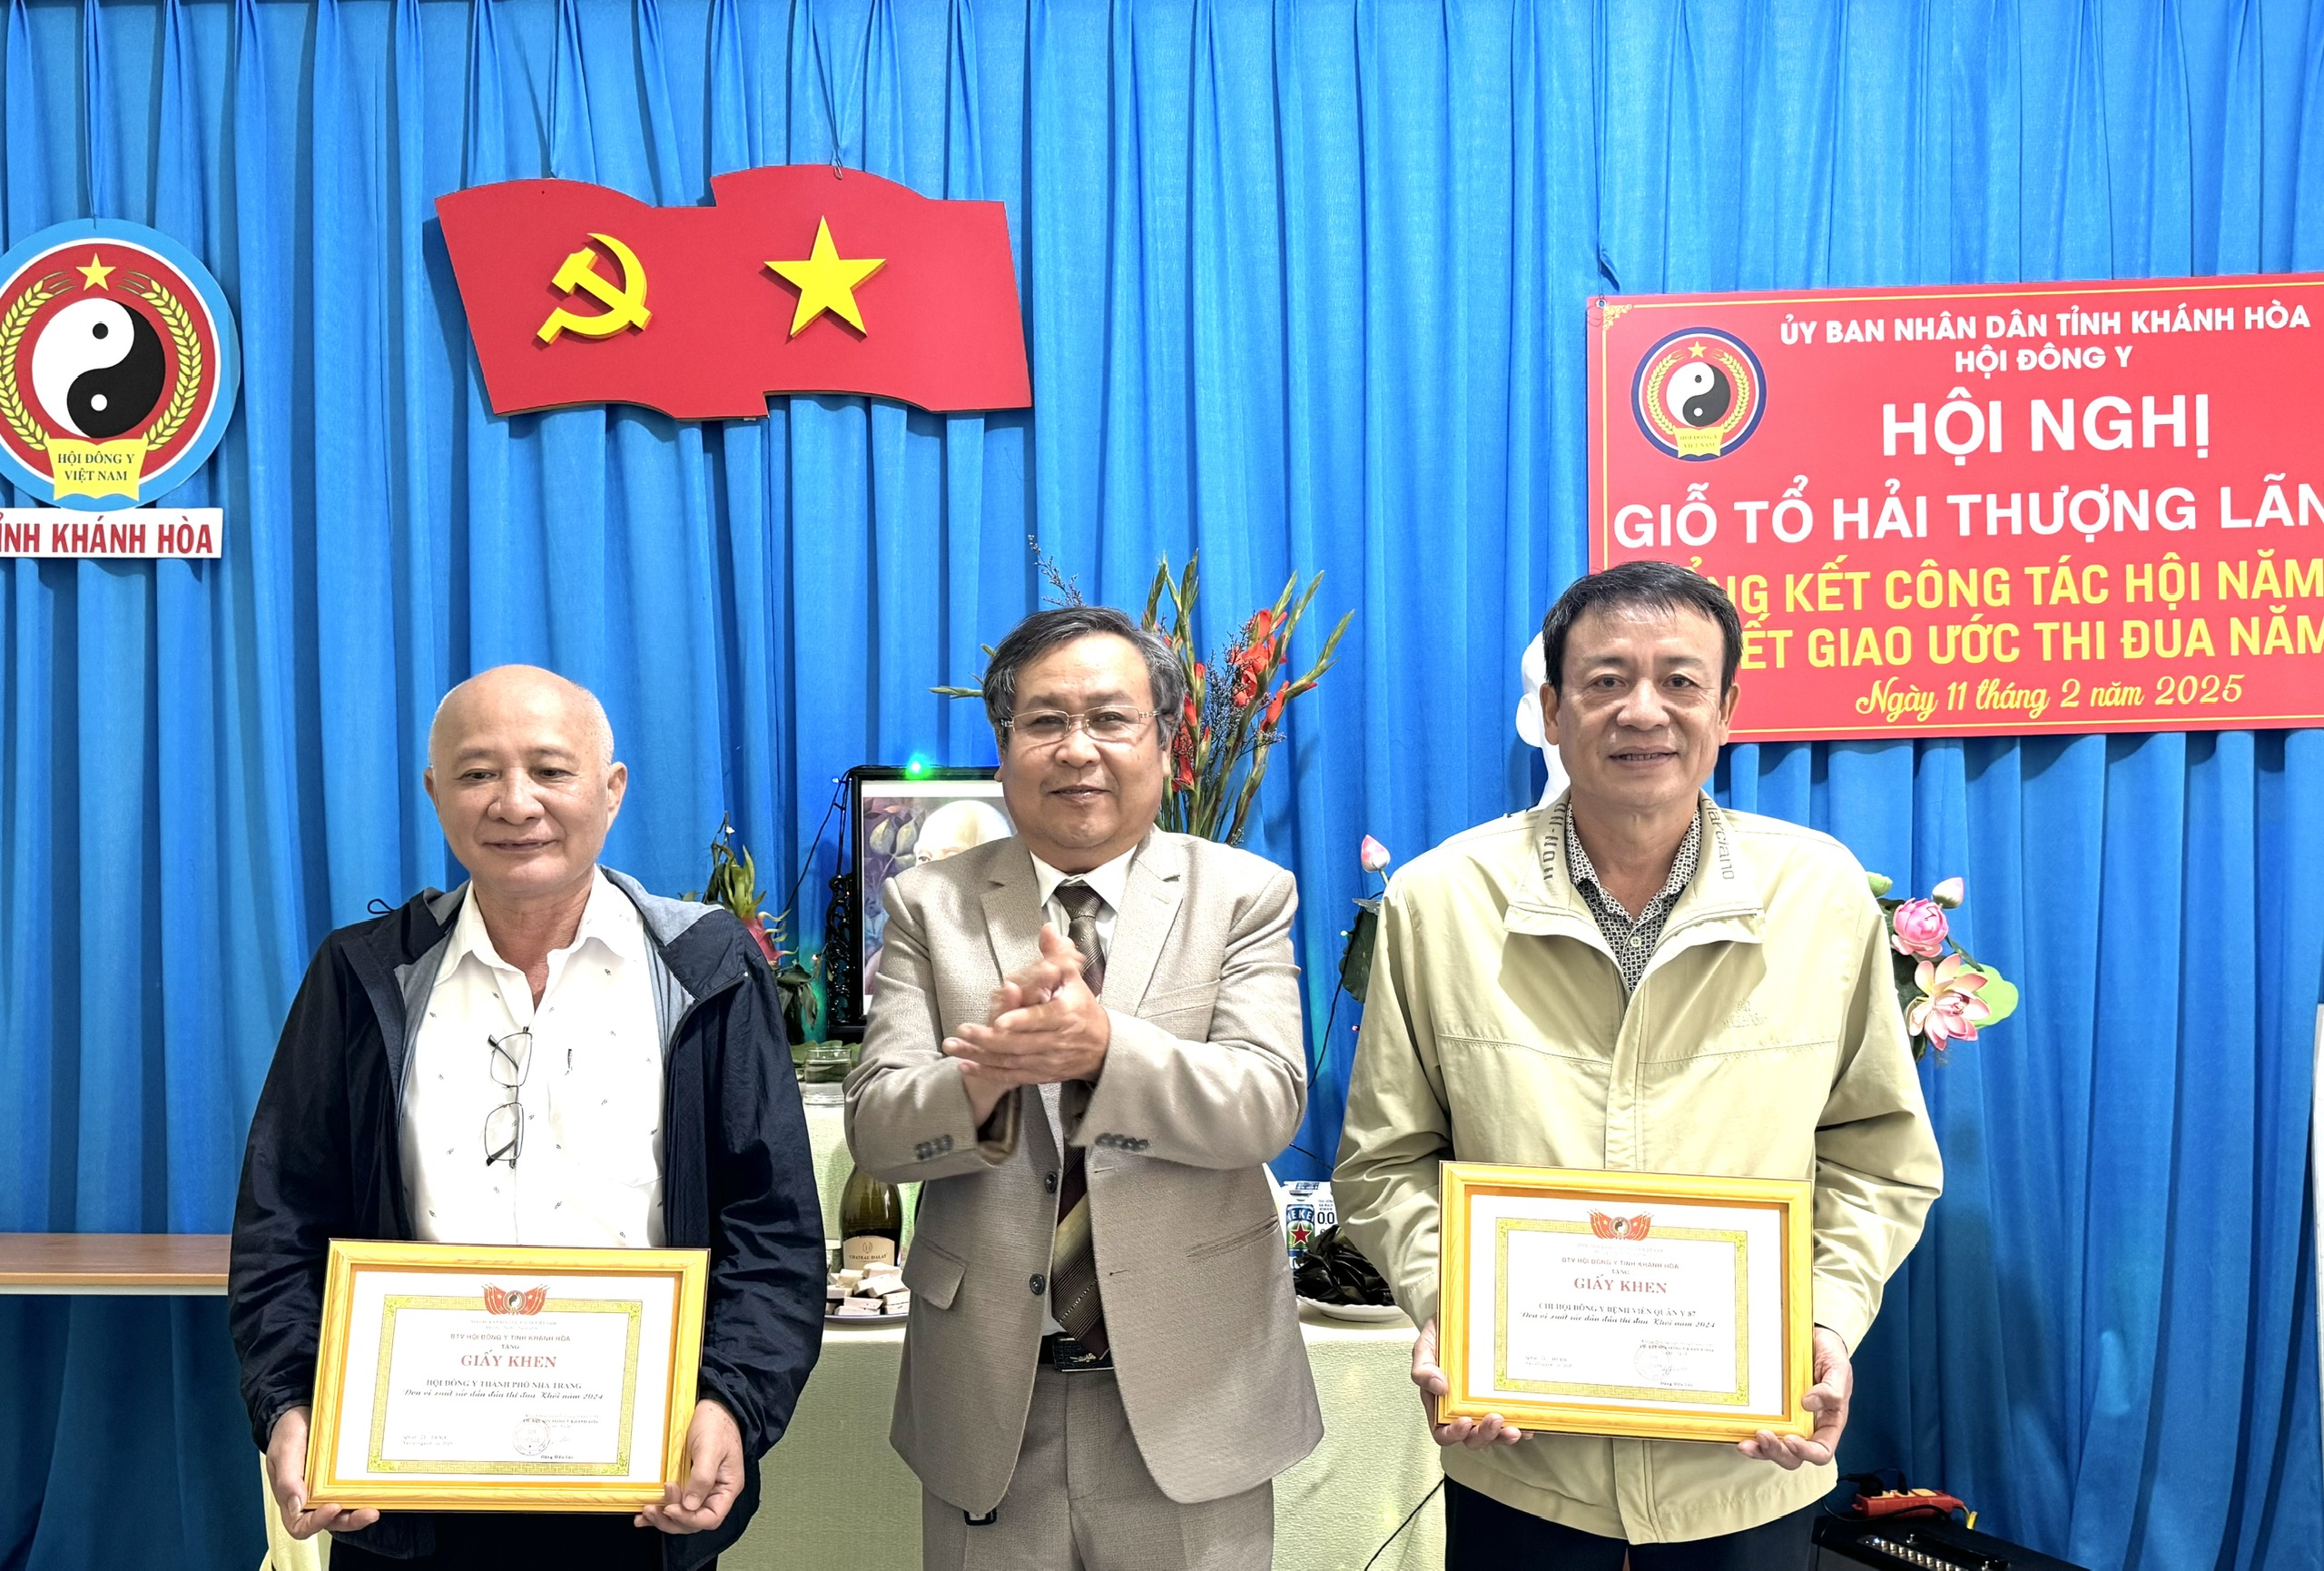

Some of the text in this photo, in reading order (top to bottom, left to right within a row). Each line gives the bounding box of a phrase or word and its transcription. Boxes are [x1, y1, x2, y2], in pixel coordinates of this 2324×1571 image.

[1780, 299, 2310, 345] ỦY BAN NHÂN DÂN TỈNH KHÁNH HÒA
[1955, 342, 2133, 379] HỘI ĐÔNG Y
[1883, 386, 2209, 466] HỘI NGHỊ
[58, 450, 134, 467] HỘI ĐÔNG Y
[64, 468, 127, 483] VIỆT NAM
[1613, 481, 1717, 548] GIỖ
[1734, 474, 1814, 544] TỔ
[1832, 478, 1927, 540] HẢI
[1946, 483, 2196, 543] THƯỢNG
[52, 515, 146, 553] KHÁNH
[158, 515, 212, 554] HÒA
[1786, 555, 1871, 613] KẾT
[1885, 558, 2010, 609] CÔNG
[2024, 555, 2109, 606] TÁC
[2125, 551, 2200, 611] HỘI
[2218, 548, 2324, 599] NĂM
[1807, 626, 1912, 667] GIAO
[1928, 614, 2020, 664] ƯỚC
[2034, 620, 2105, 661] THI
[2121, 618, 2215, 659] ĐUA
[2230, 604, 2324, 656] NĂM
[1856, 674, 2245, 723] Ngày 11 tháng 2 năm 2025
[1701, 798, 1735, 880] Marciano
[1317, 1211, 1334, 1224] 0.0
[1574, 1274, 1667, 1294] GIẤY KHEN
[461, 1349, 556, 1368] GIẤY KHEN
